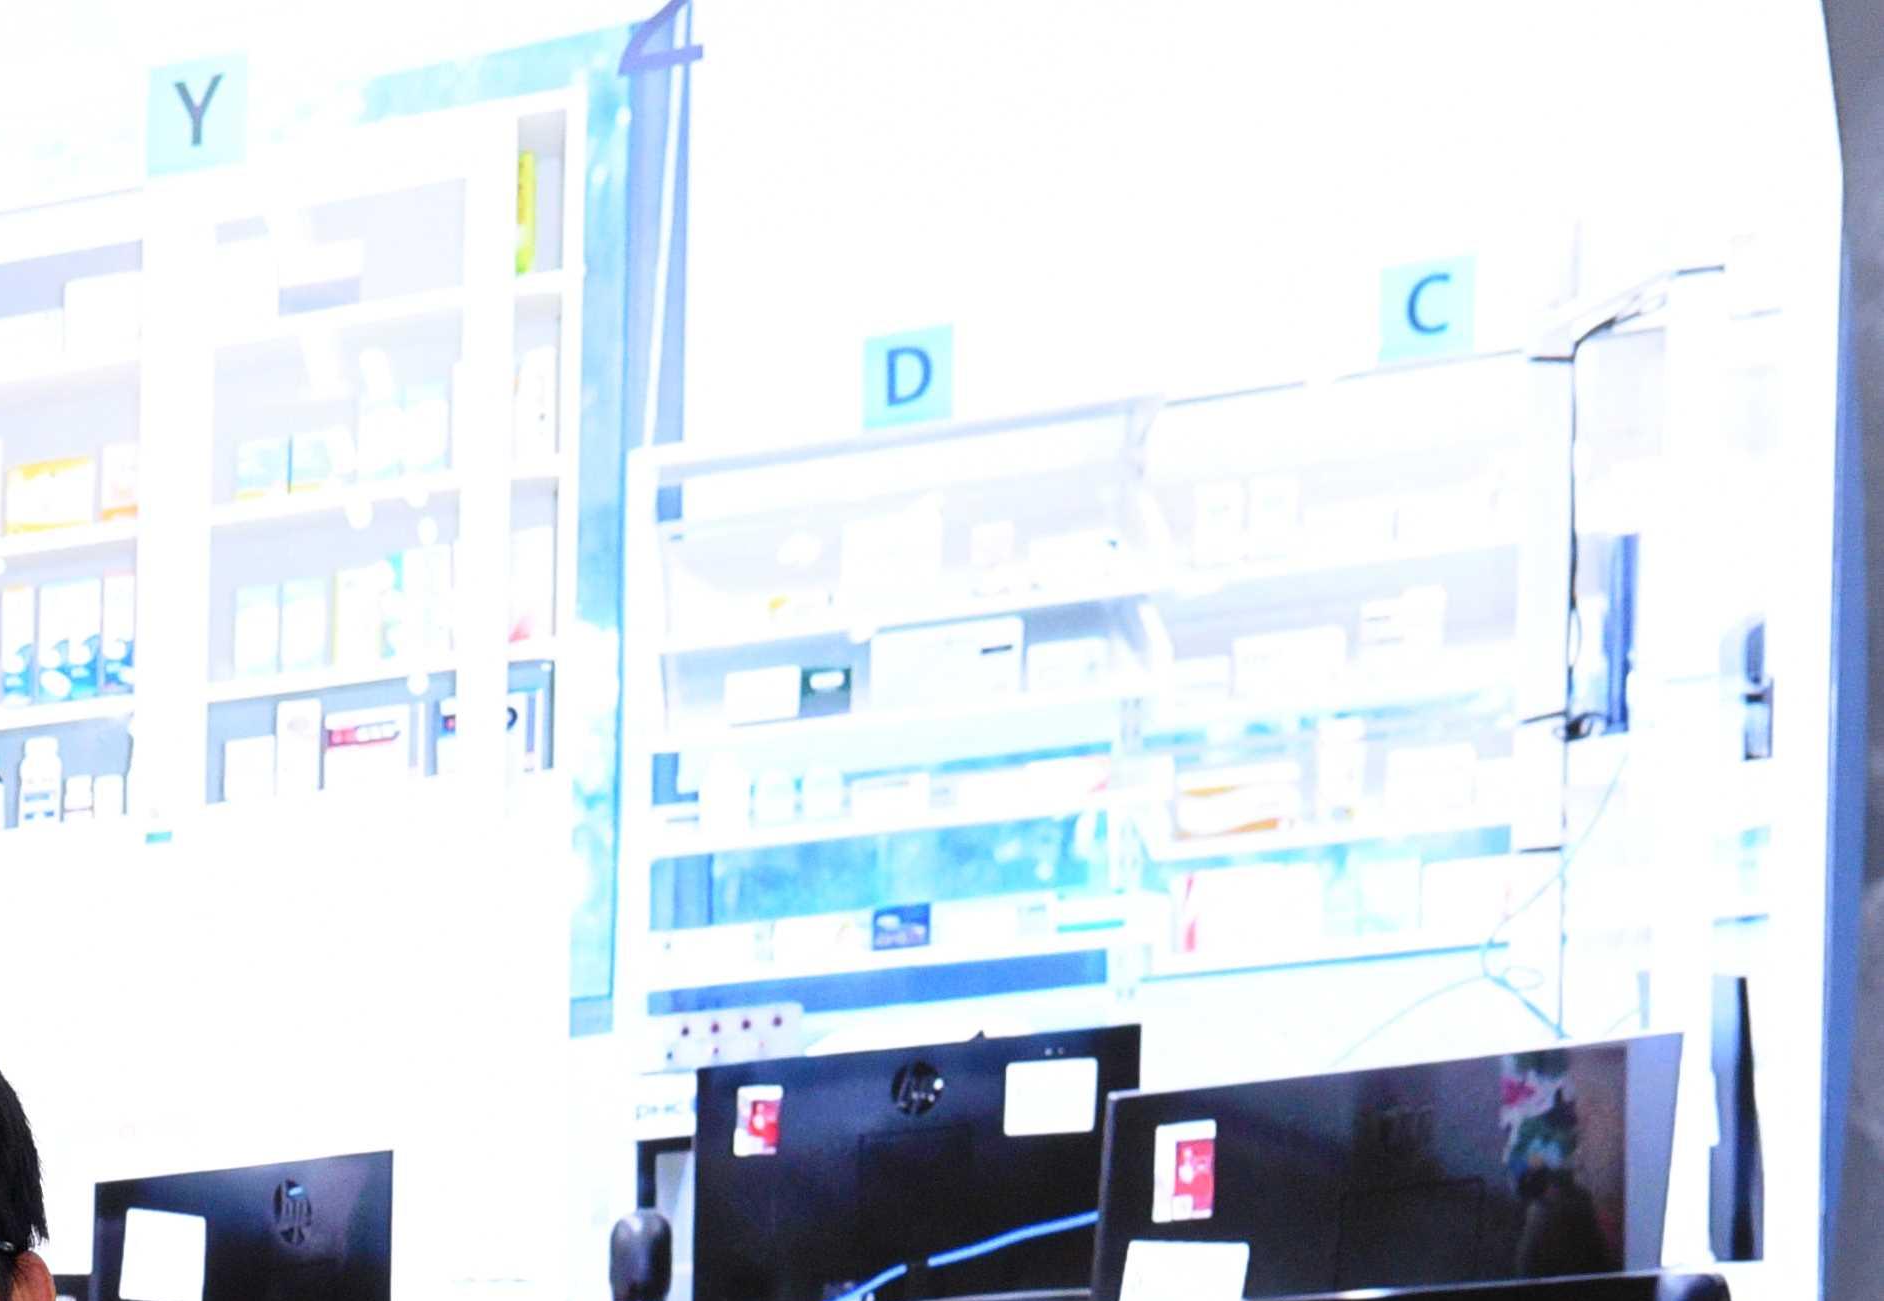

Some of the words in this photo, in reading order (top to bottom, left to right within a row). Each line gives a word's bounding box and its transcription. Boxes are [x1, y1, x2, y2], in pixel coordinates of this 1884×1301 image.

[174, 74, 223, 147] Y
[1405, 272, 1452, 335] C
[886, 346, 932, 407] D
